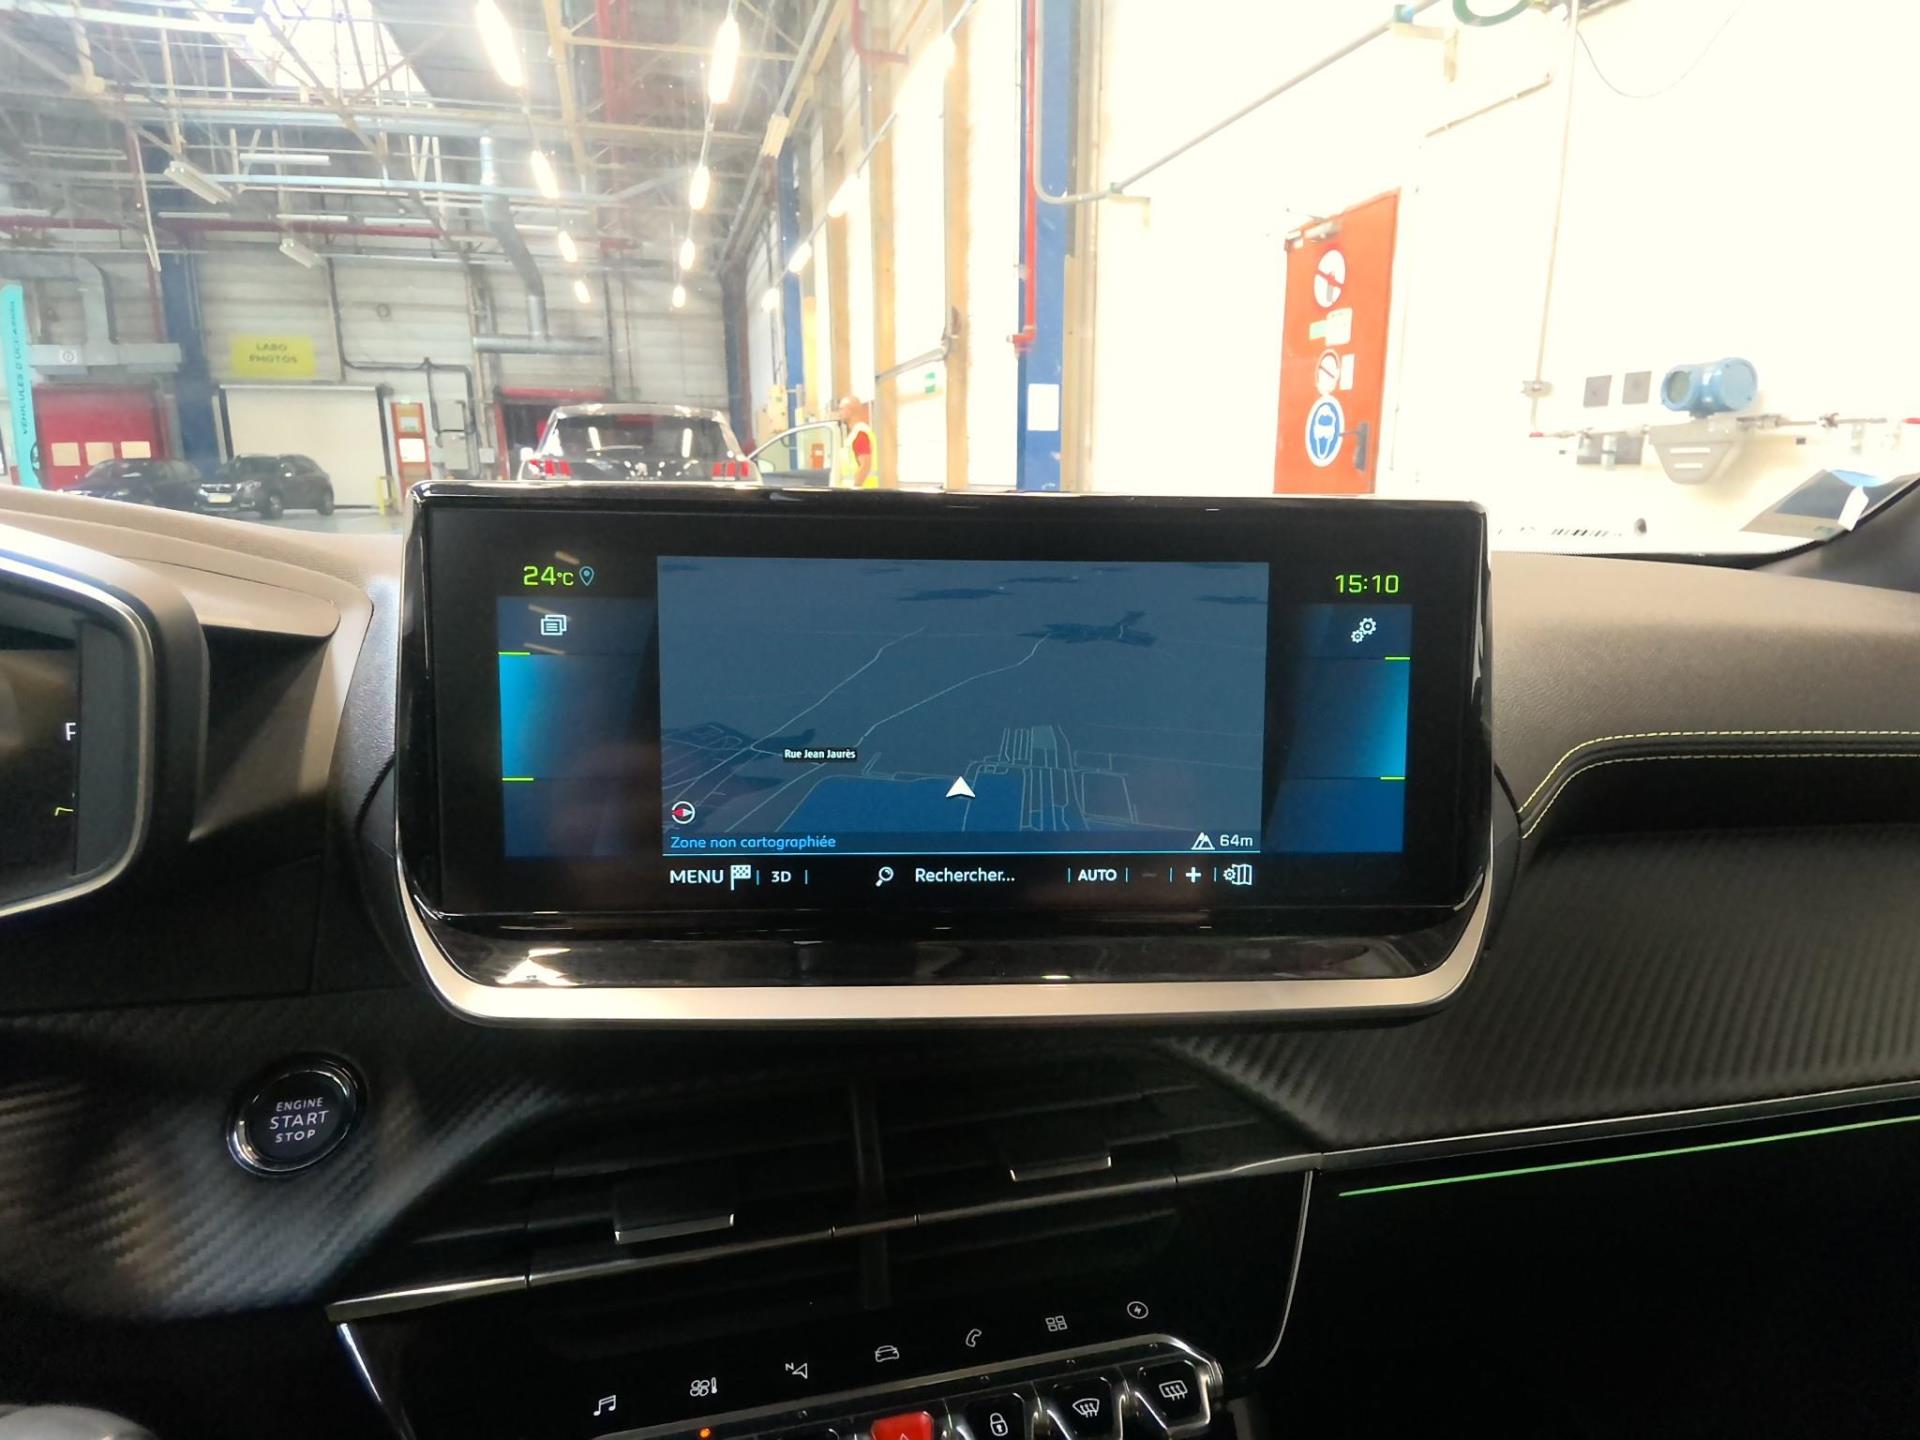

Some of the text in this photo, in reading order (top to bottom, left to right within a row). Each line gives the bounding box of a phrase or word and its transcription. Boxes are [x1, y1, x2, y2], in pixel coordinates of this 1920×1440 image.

[255, 343, 288, 351] LABO
[248, 354, 297, 363] PHOTOS
[1334, 574, 1400, 594] 15:10
[784, 748, 856, 759] Rue Jean Jaurès
[670, 835, 837, 850] Zone non cartographiée
[1219, 834, 1254, 847] 64m
[669, 869, 724, 884] MENU
[771, 871, 792, 883] 3D
[915, 867, 1015, 883] Rechercher...
[1077, 868, 1118, 881] AUTO
[276, 1097, 324, 1112] ENGINE
[269, 1110, 330, 1130] START
[275, 1129, 316, 1143] STOP
